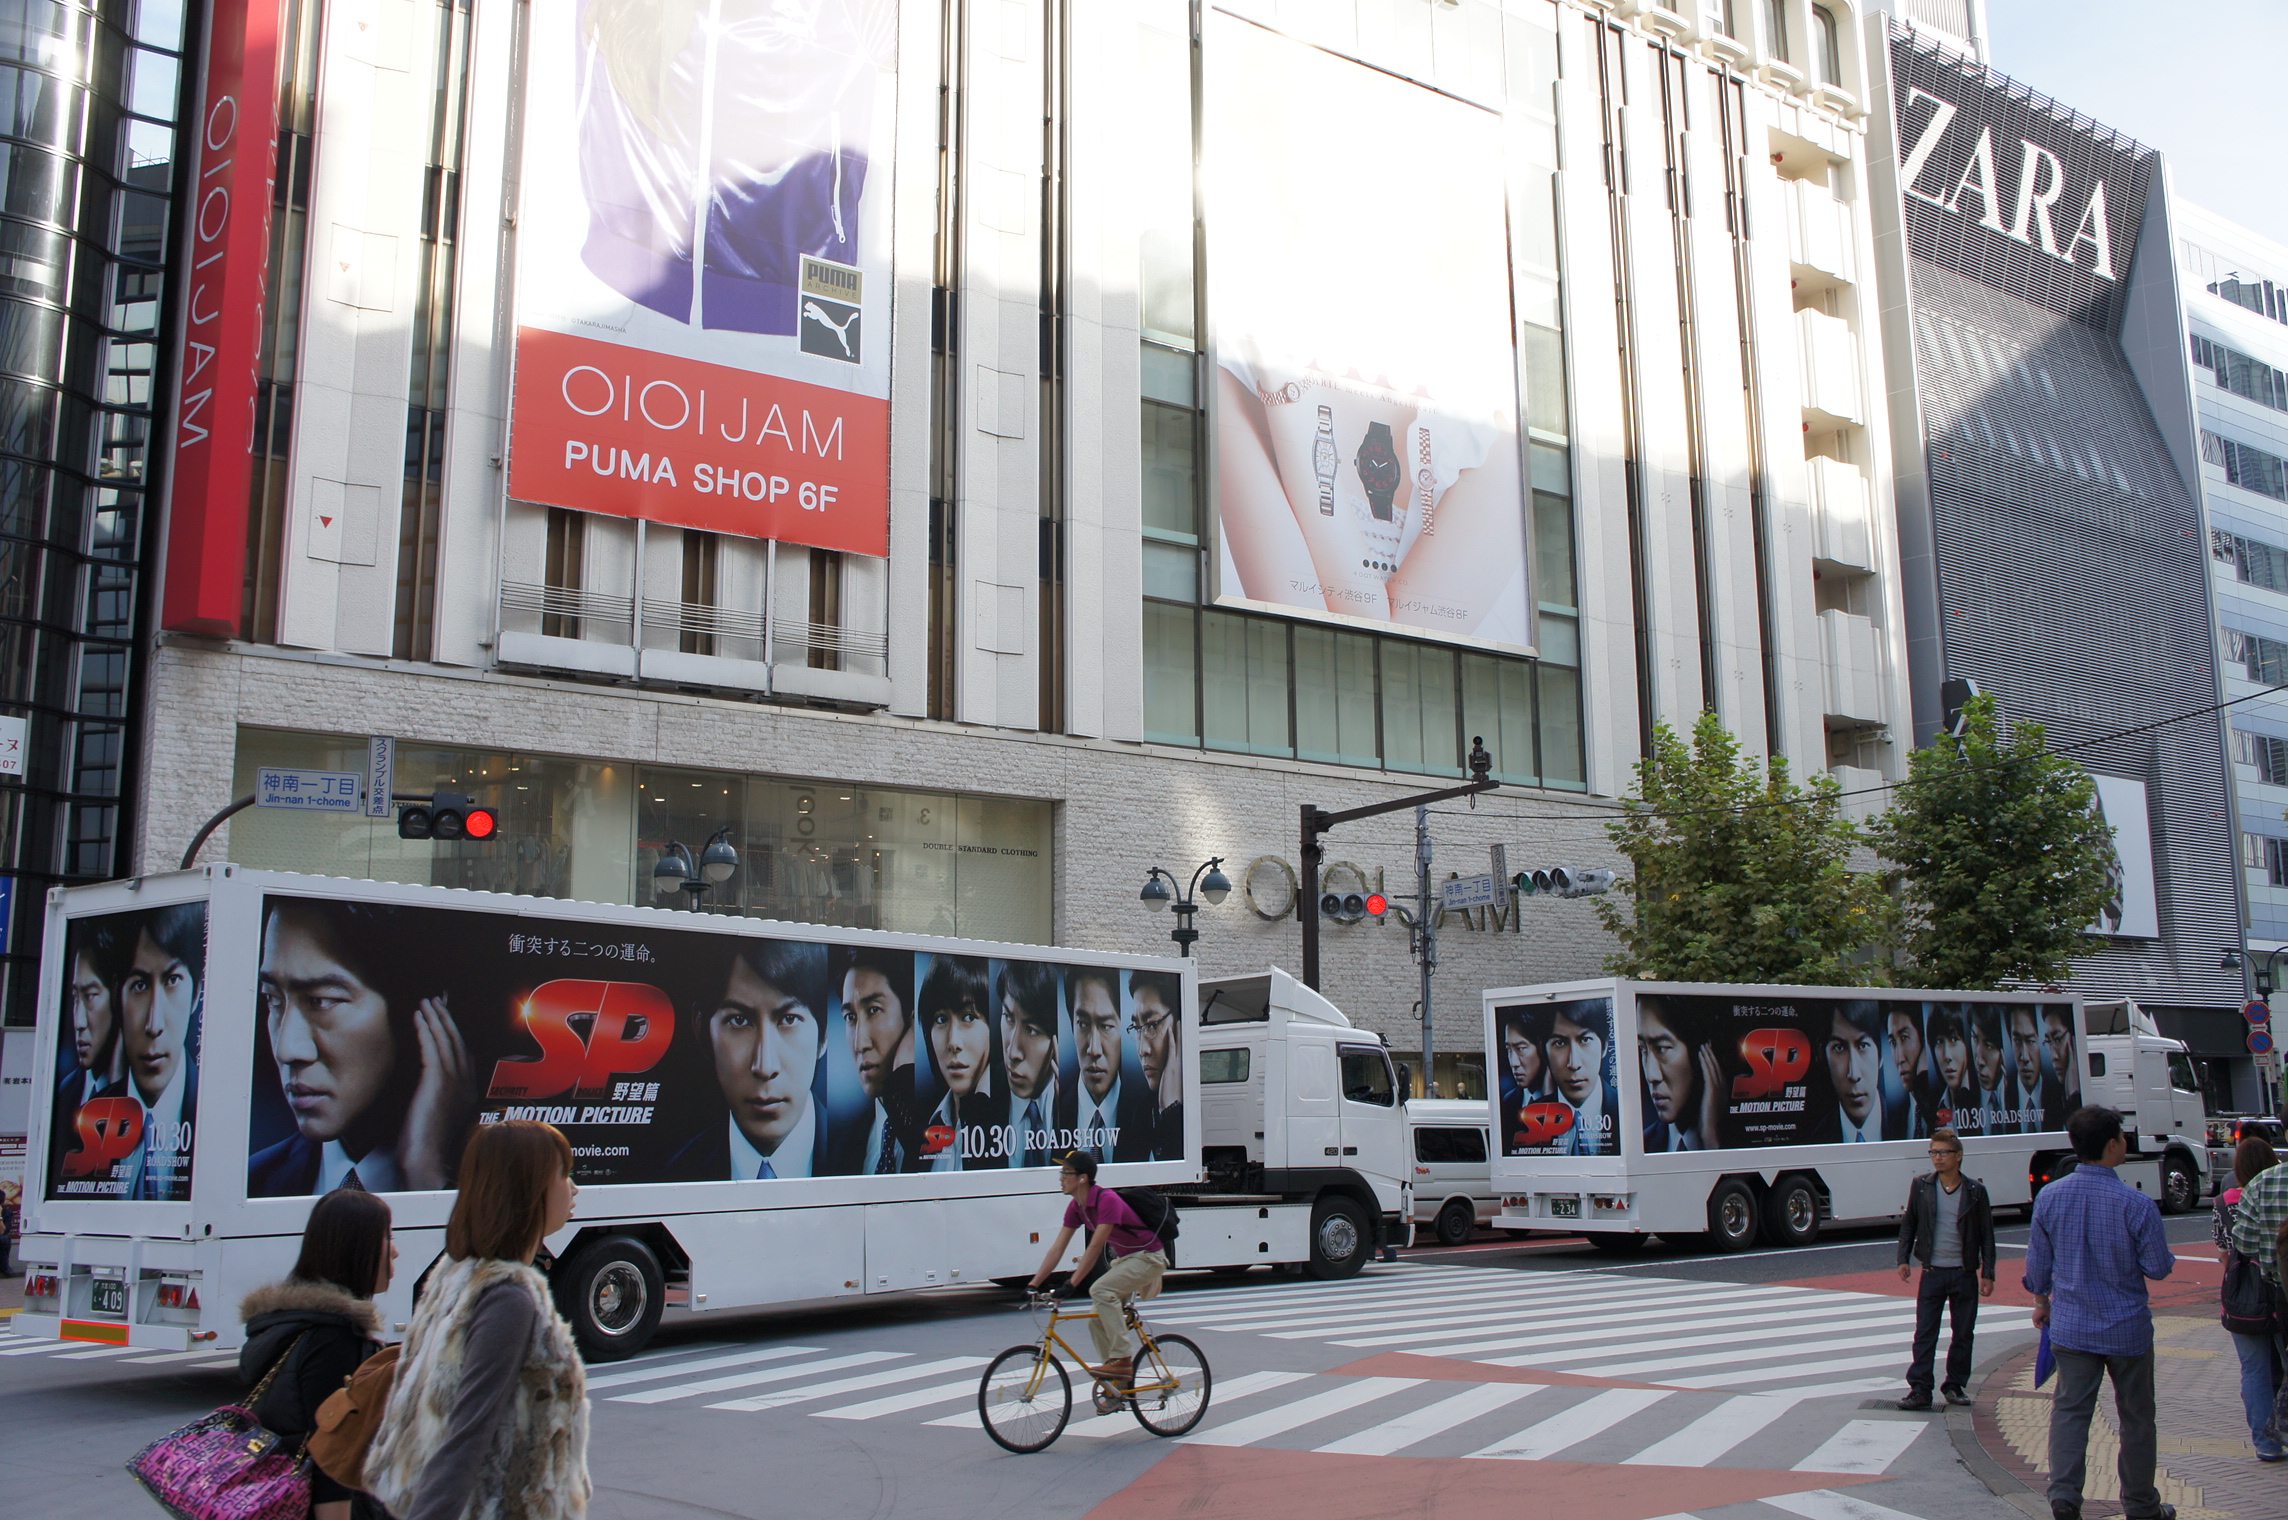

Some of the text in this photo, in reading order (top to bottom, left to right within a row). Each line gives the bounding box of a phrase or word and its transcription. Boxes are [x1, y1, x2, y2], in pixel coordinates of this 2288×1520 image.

[1901, 85, 2118, 282] ZARA
[807, 262, 858, 292] PUMA
[807, 281, 858, 299] ARCHIVE
[565, 440, 839, 513] PUMA SHOP 6F
[263, 773, 355, 796] 神南一丁目
[372, 738, 388, 815] スクランブル交差点
[265, 794, 351, 808] Jin-nan 1-chome
[922, 841, 1039, 858] DOUBLE STANDARD CLOTHING
[1444, 878, 1491, 898] 神南一丁目
[1448, 894, 1491, 906] Jin-nan 1-chome
[508, 933, 657, 964] 衝突する二つの運命。
[1732, 1005, 1799, 1018] 衝突する二つの運命。
[486, 977, 676, 1100] SP
[1732, 1027, 1812, 1100] SP
[612, 1082, 661, 1102] 野望篇
[479, 1106, 655, 1125] THE MOTION PICTURE
[1739, 1101, 1771, 1113] MOTION
[1772, 1100, 1806, 1112] PICTURE
[1512, 1102, 1575, 1147] SP
[1578, 1113, 1613, 1132] 10.30
[1745, 1123, 1797, 1133] www.sp-movie.com
[1955, 1107, 1987, 1131] 10.30
[1990, 1108, 2046, 1125] ROADSHOW
[61, 1096, 144, 1178] SP
[147, 1121, 192, 1153] 10.30
[961, 1124, 1018, 1159] 10.30
[1024, 1127, 1122, 1151] ROADSHOW
[1578, 1132, 1613, 1140] ROADSHOW
[1518, 1147, 1542, 1155] MOTION
[1543, 1146, 1568, 1155] PICTURE
[146, 1156, 190, 1168] ROADSHOW
[66, 1181, 96, 1194] MOTION
[96, 1181, 130, 1194] PICTURE
